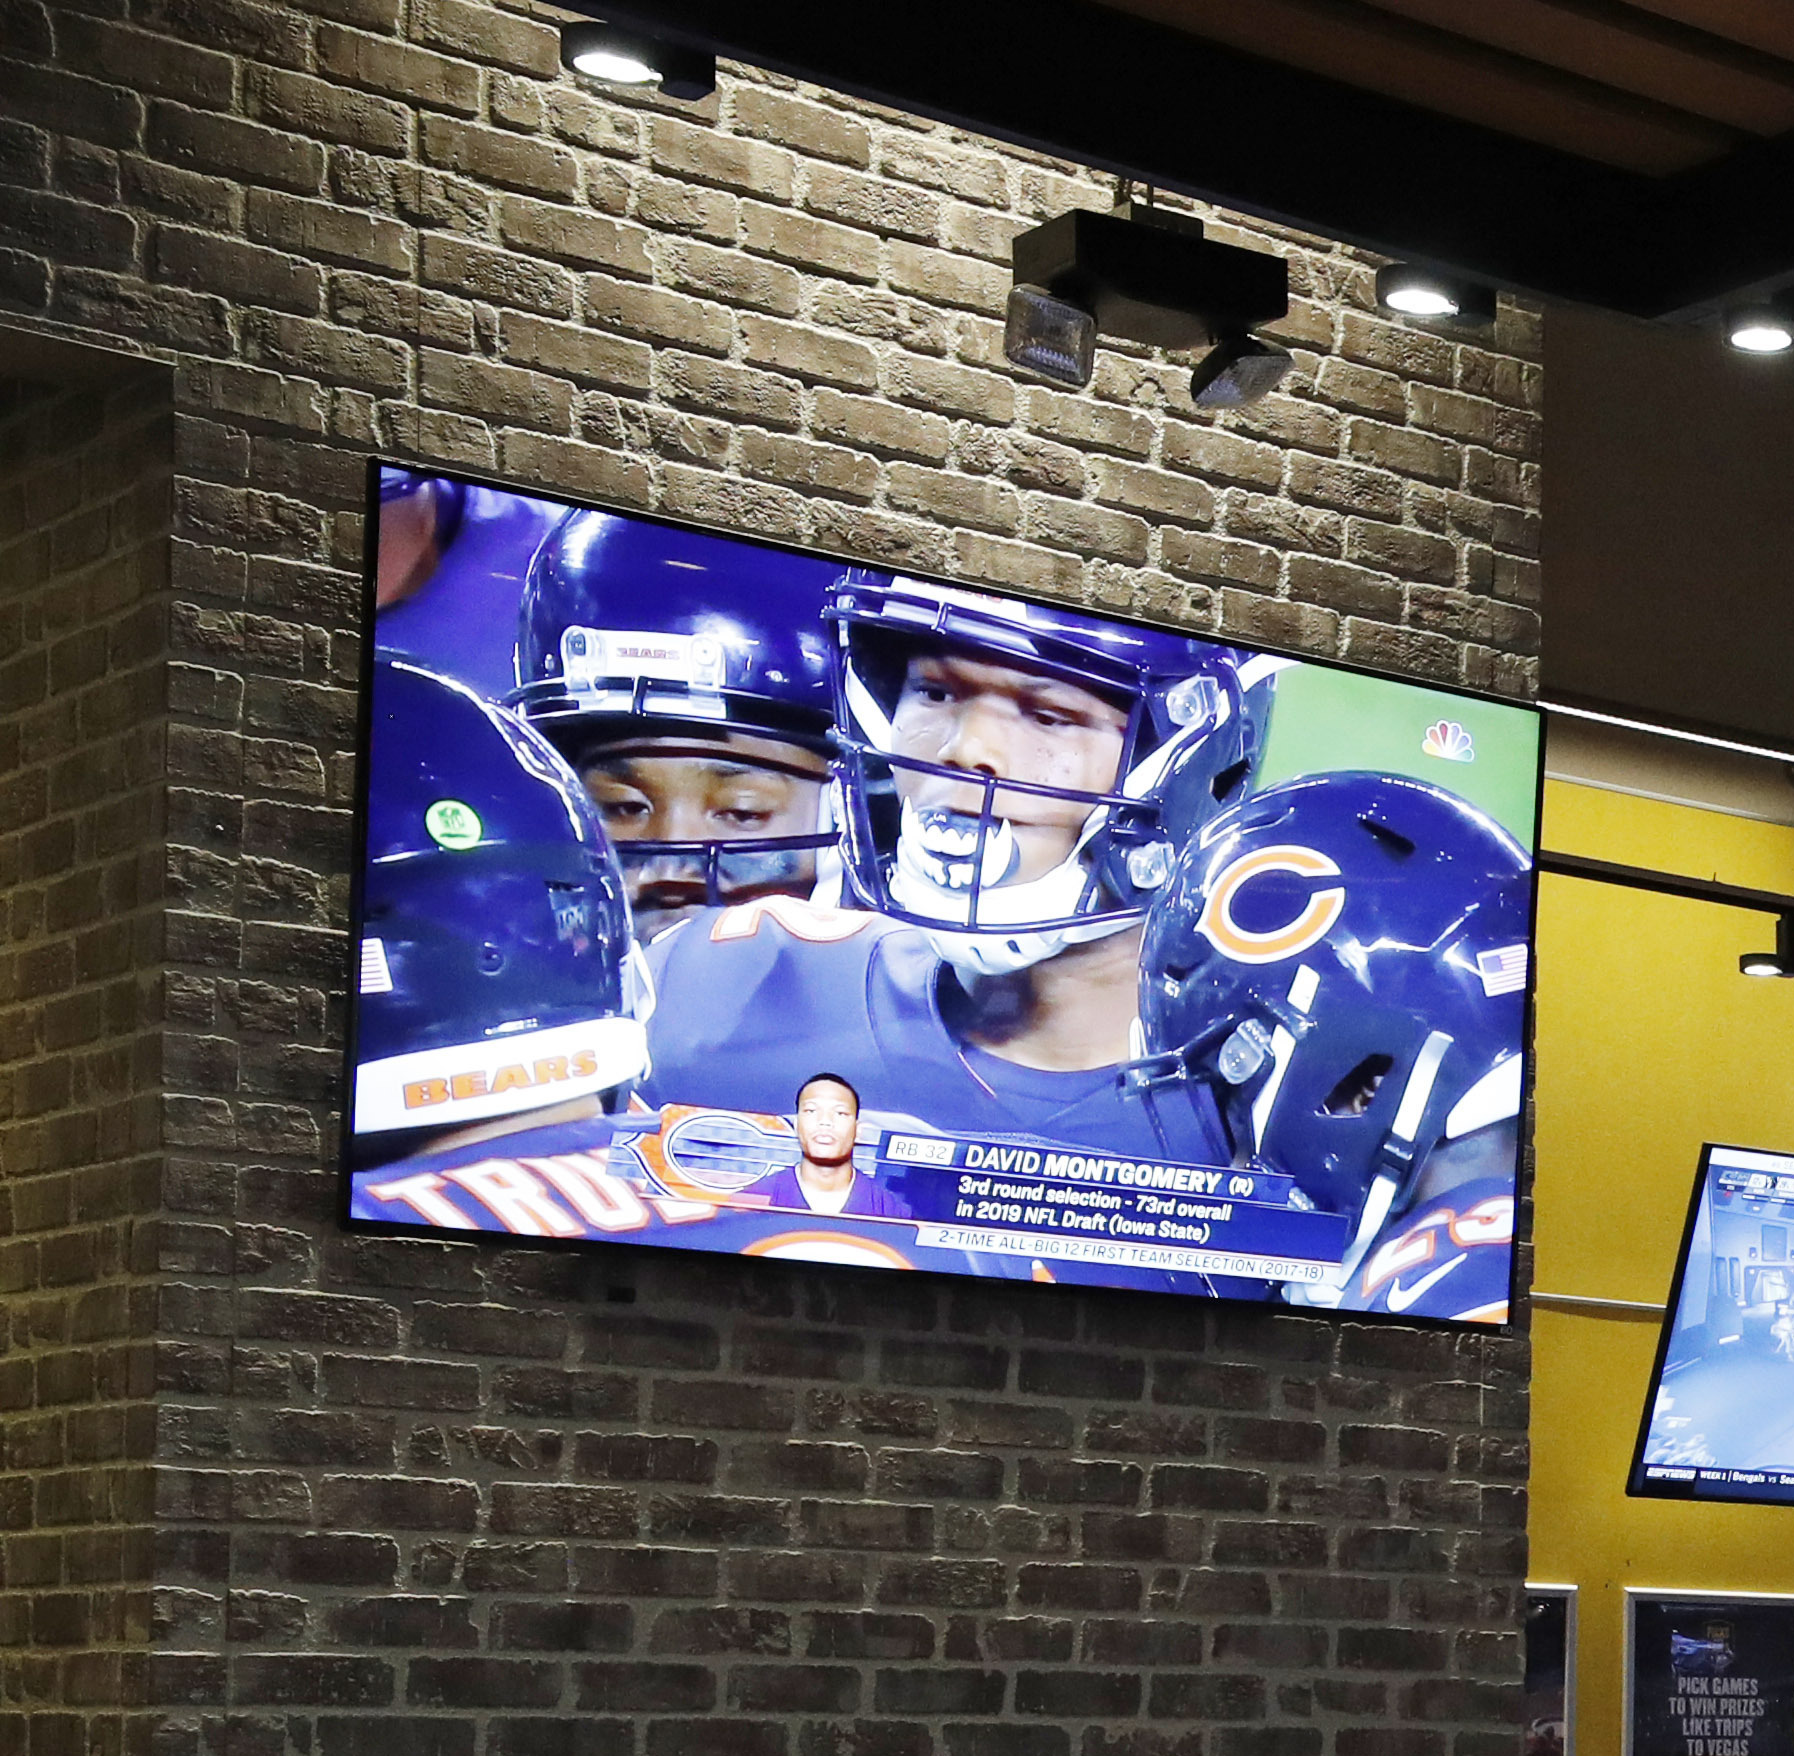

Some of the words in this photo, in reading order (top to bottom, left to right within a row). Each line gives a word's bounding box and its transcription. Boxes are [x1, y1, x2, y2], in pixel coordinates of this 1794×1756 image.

[402, 1048, 599, 1110] BEARS
[895, 1140, 918, 1157] RB
[924, 1144, 948, 1160] 32
[965, 1144, 1041, 1174] DAVID
[1043, 1153, 1223, 1195] MONTGOMERY
[1228, 1175, 1255, 1198] (R)
[958, 1175, 992, 1196] 3rd
[992, 1181, 1045, 1202] round
[1045, 1186, 1122, 1210] selection
[1136, 1194, 1177, 1216] 73rd
[1177, 1203, 1233, 1222] overall
[955, 1199, 974, 1218] in
[975, 1201, 1022, 1223] 2019
[1023, 1206, 1058, 1227] NFL
[1061, 1210, 1107, 1231] Draft
[1108, 1213, 1156, 1236] (Iowa
[1158, 1220, 1211, 1245] State)
[939, 1229, 996, 1248] 2-TIME
[999, 1234, 1060, 1254] ALL-BIG
[1065, 1242, 1080, 1257] 12
[1083, 1244, 1126, 1260] FIRST
[1131, 1249, 1173, 1265] TEAM
[1175, 1253, 1256, 1273] SELECTION
[1259, 1258, 1325, 1282] (2017-18)
[1732, 1471, 1766, 1484] Bengals
[1677, 1676, 1709, 1697] PICK
[1711, 1676, 1759, 1697] GAMES
[1668, 1696, 1687, 1716] TO
[1688, 1697, 1717, 1717] WIN
[1718, 1697, 1765, 1718] PRIZES
[1681, 1717, 1710, 1737] LIKE
[1713, 1718, 1754, 1738] TRIPS
[1686, 1738, 1705, 1756] TO
